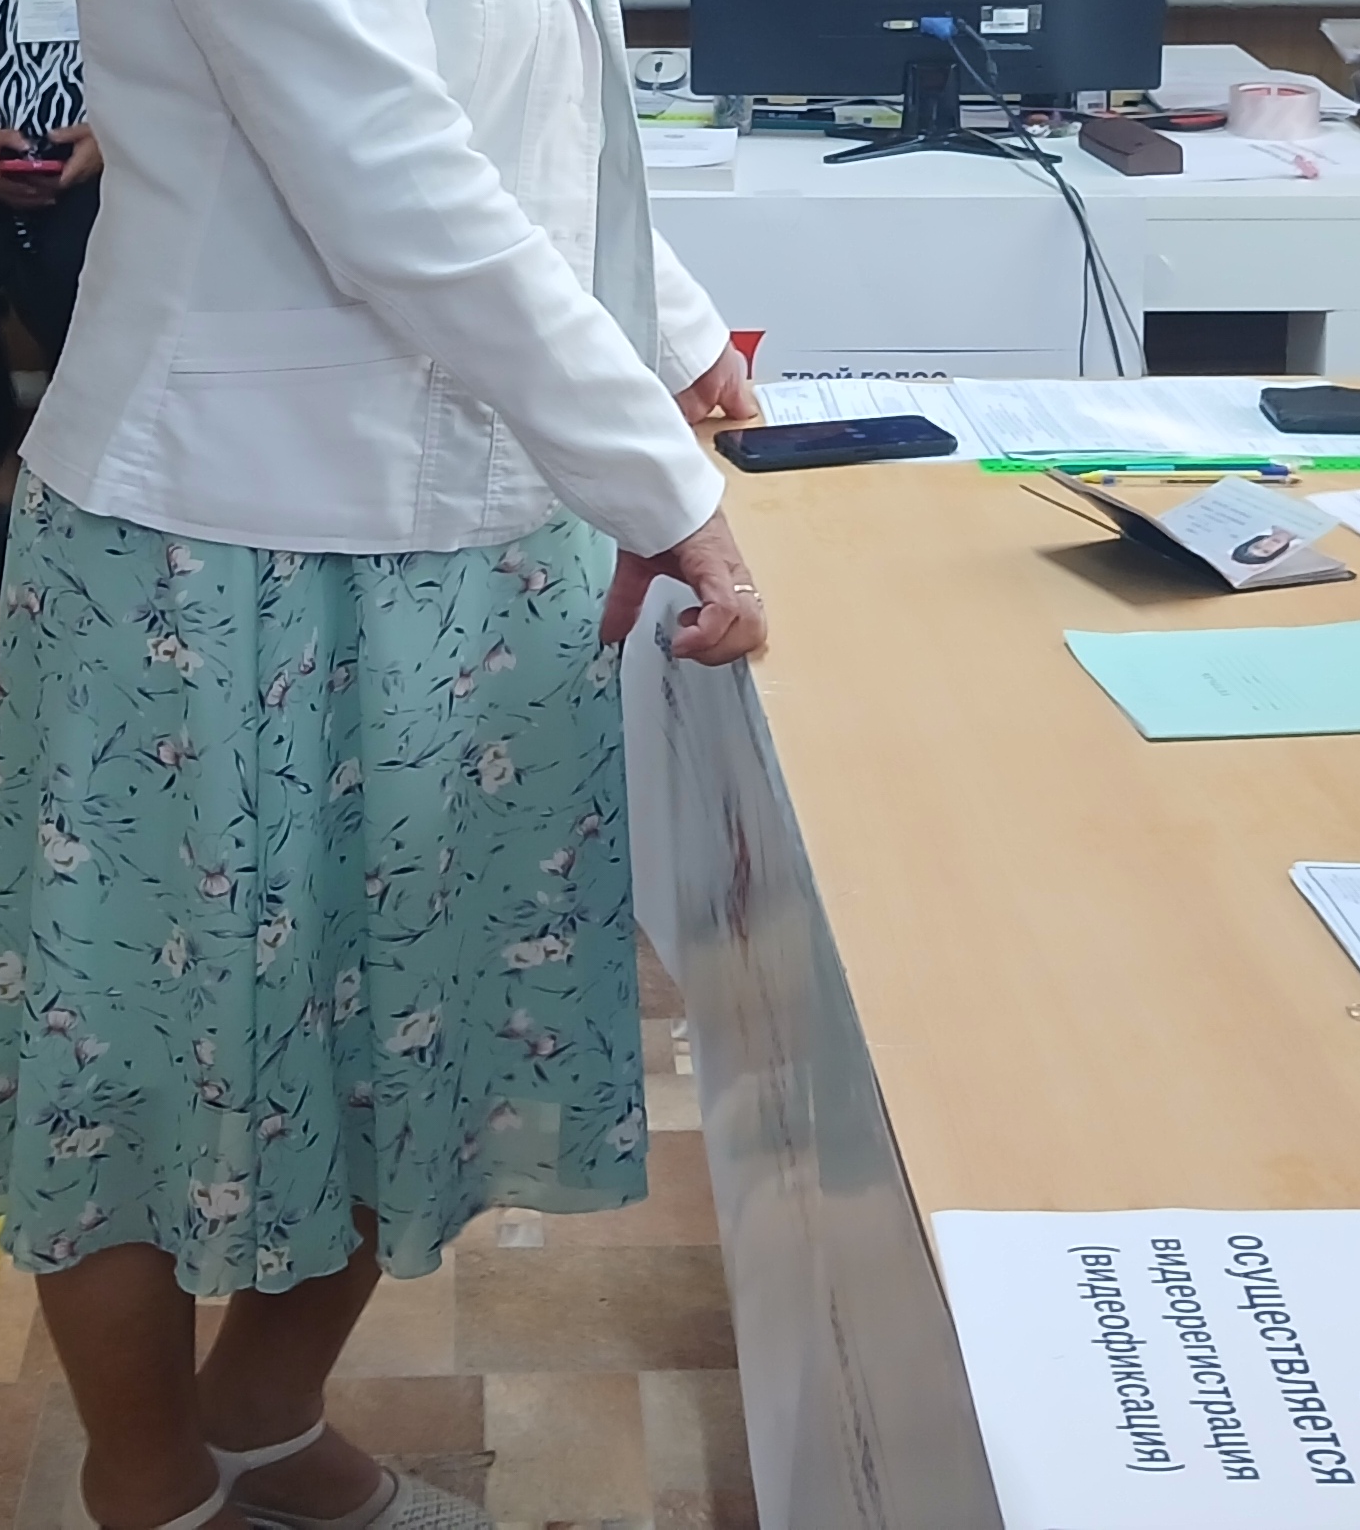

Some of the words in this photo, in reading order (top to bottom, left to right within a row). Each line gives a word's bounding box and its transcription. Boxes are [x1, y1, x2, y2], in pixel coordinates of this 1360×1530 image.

[1068, 1246, 1186, 1472] (видеофиксация)
[1148, 1239, 1260, 1480] видеорегистрация
[1224, 1235, 1355, 1484] осуществляется
